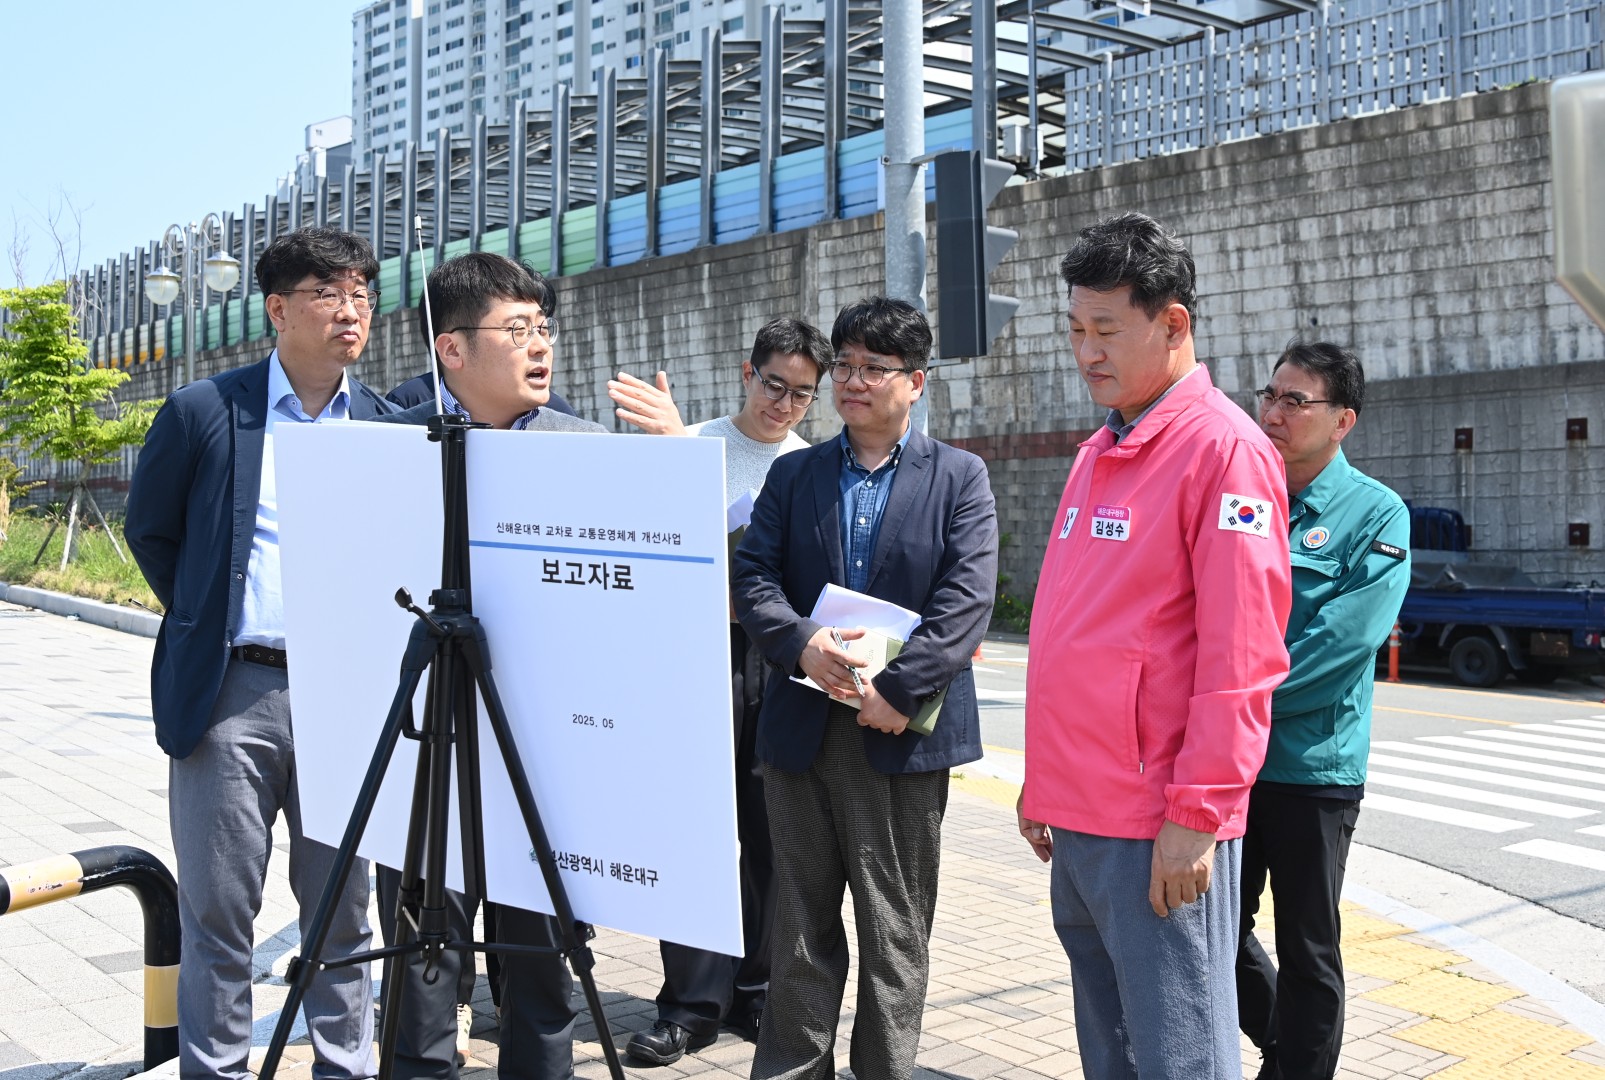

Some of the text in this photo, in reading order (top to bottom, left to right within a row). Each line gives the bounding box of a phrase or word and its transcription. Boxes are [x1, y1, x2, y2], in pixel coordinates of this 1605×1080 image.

[496, 522, 682, 546] 신해운대역 교차로 교통운영체계 개선사업
[1095, 520, 1124, 538] 김성수
[541, 558, 635, 591] 보고자료
[572, 713, 615, 729] 2025. 05
[609, 862, 659, 888] 해운대구
